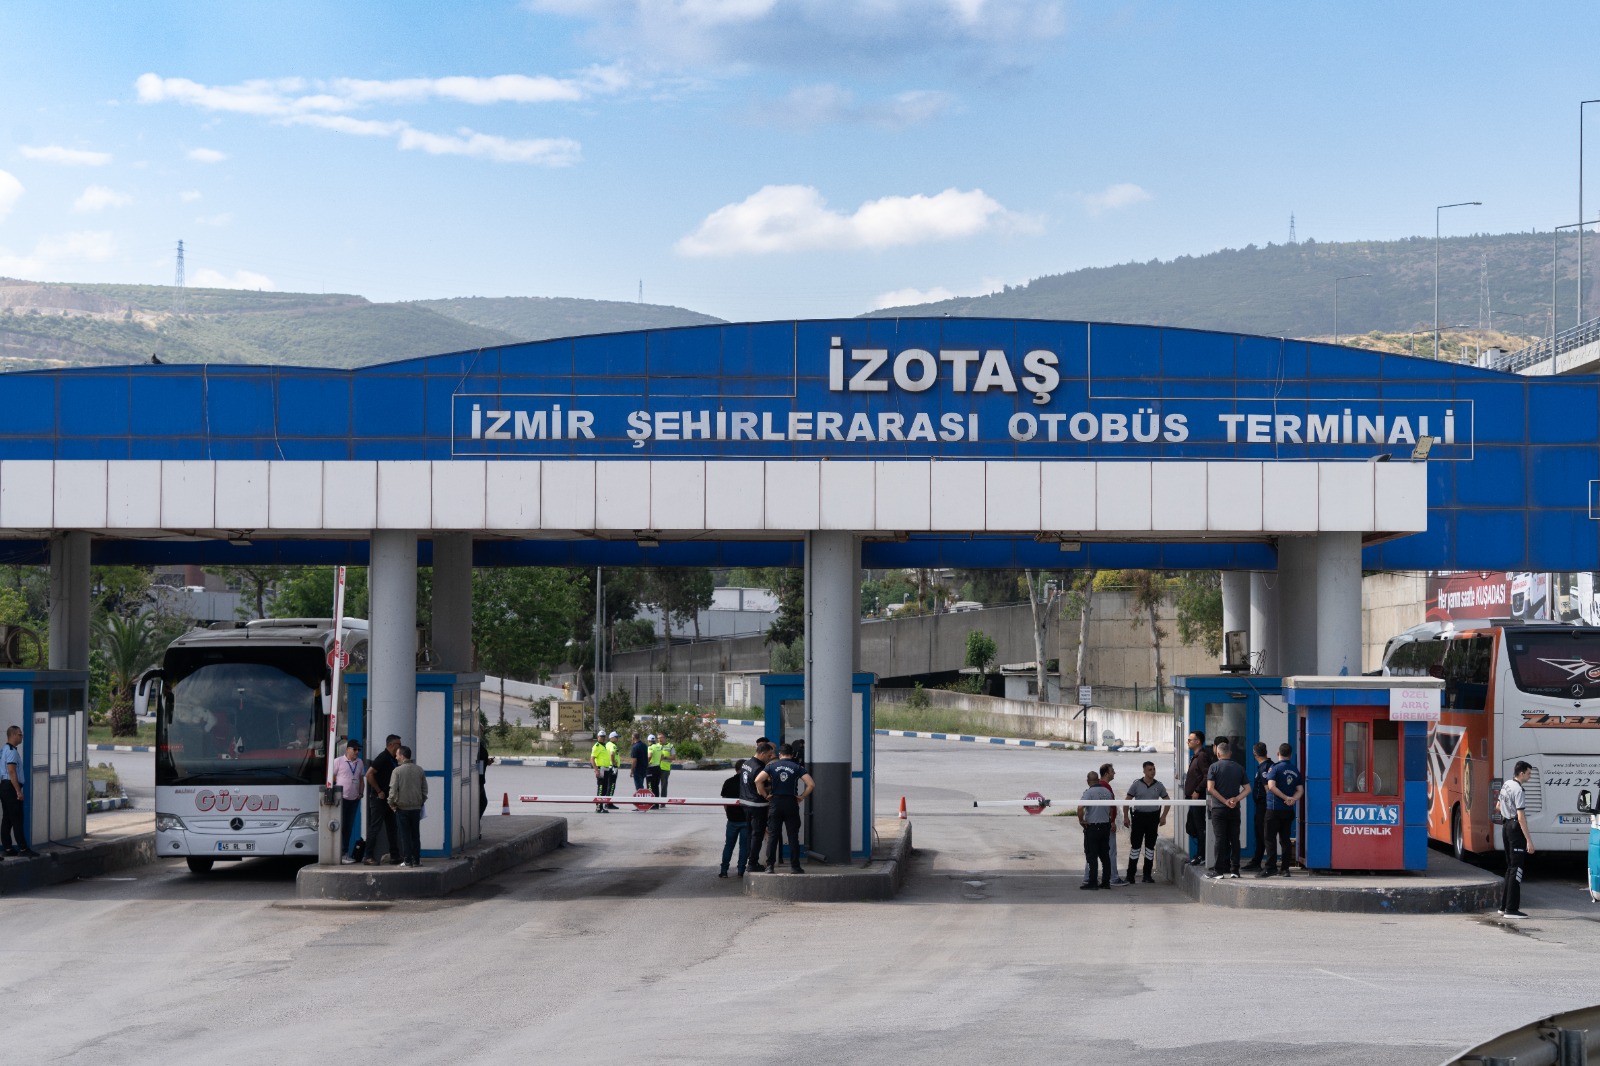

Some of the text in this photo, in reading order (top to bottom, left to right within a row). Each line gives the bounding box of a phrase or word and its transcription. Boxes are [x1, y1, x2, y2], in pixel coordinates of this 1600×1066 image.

[829, 336, 1060, 404] İZOTAŞ
[471, 404, 595, 440] İZMİR
[1007, 408, 1189, 443] OTOBÜS
[1218, 408, 1455, 444] TERMİNALİ
[1475, 584, 1506, 610] KUŞADASI
[1401, 689, 1429, 699] ÖZEL
[1401, 701, 1430, 710] ARAÇ
[1391, 711, 1439, 720] GİREMEZ
[1544, 778, 1571, 787] 444
[1573, 778, 1591, 787] 22
